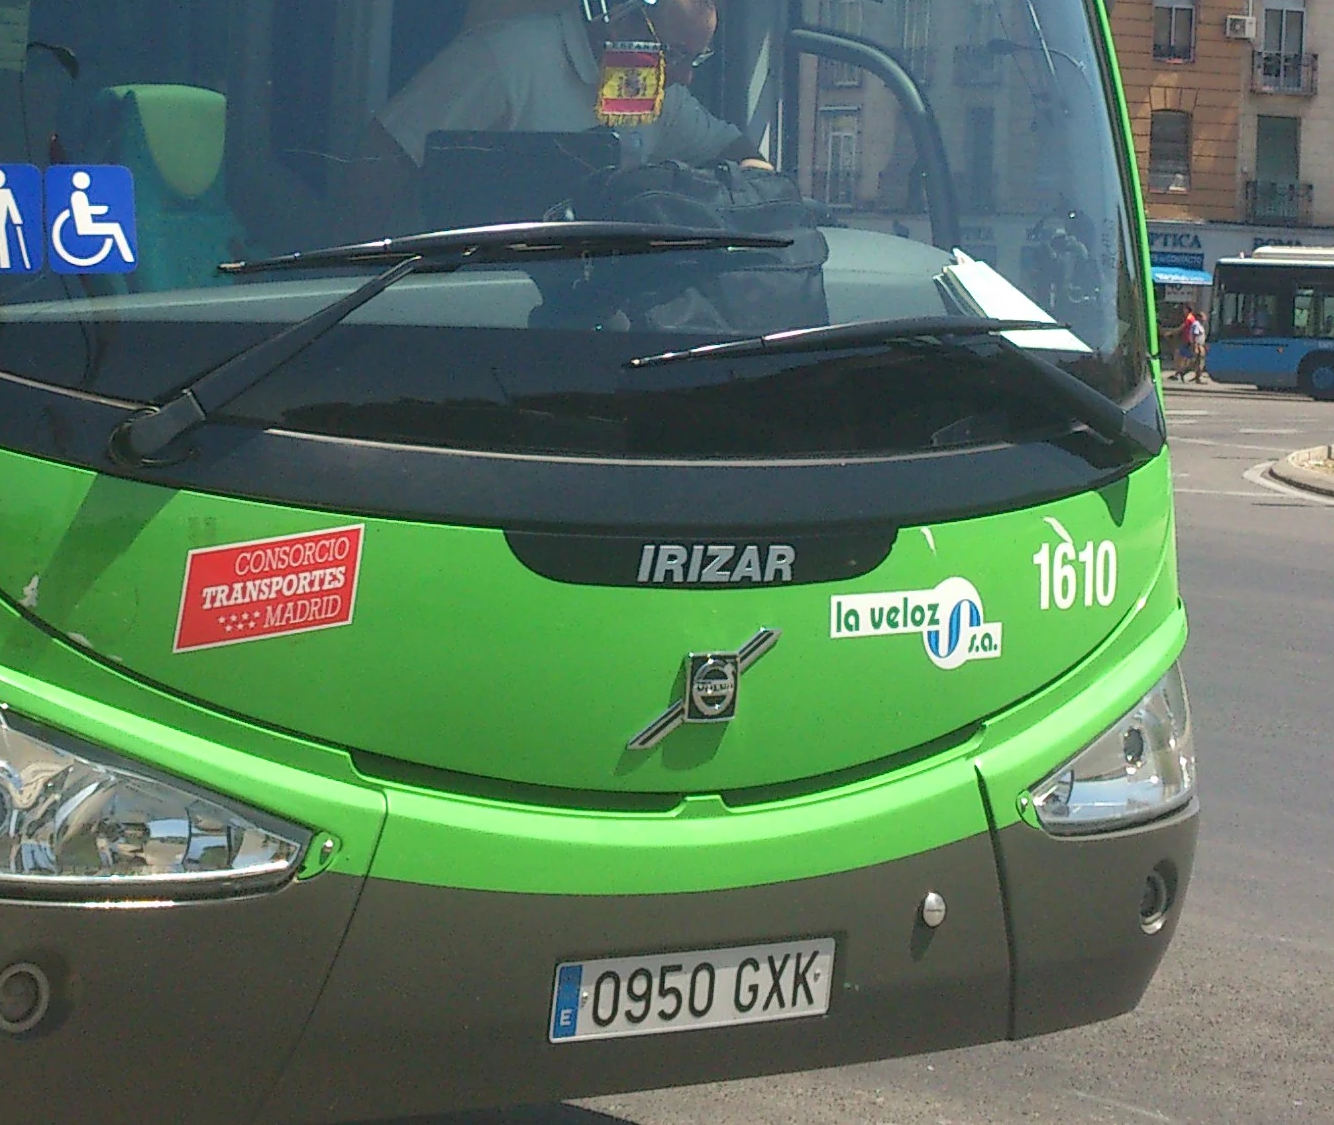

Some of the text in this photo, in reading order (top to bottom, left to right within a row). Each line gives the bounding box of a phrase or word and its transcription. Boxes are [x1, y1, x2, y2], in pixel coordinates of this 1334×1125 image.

[1150, 233, 1202, 248] PTICA
[234, 536, 350, 576] CONSORCIO
[636, 544, 797, 583] IRIZAR
[1032, 539, 1117, 610] 1610
[202, 565, 347, 610] TRANSPORTES
[263, 594, 342, 629] MADRID
[835, 596, 941, 633] la veloz
[967, 630, 999, 653] s.a.
[591, 949, 820, 1028] 0950 GXK
[559, 1008, 573, 1027] E
